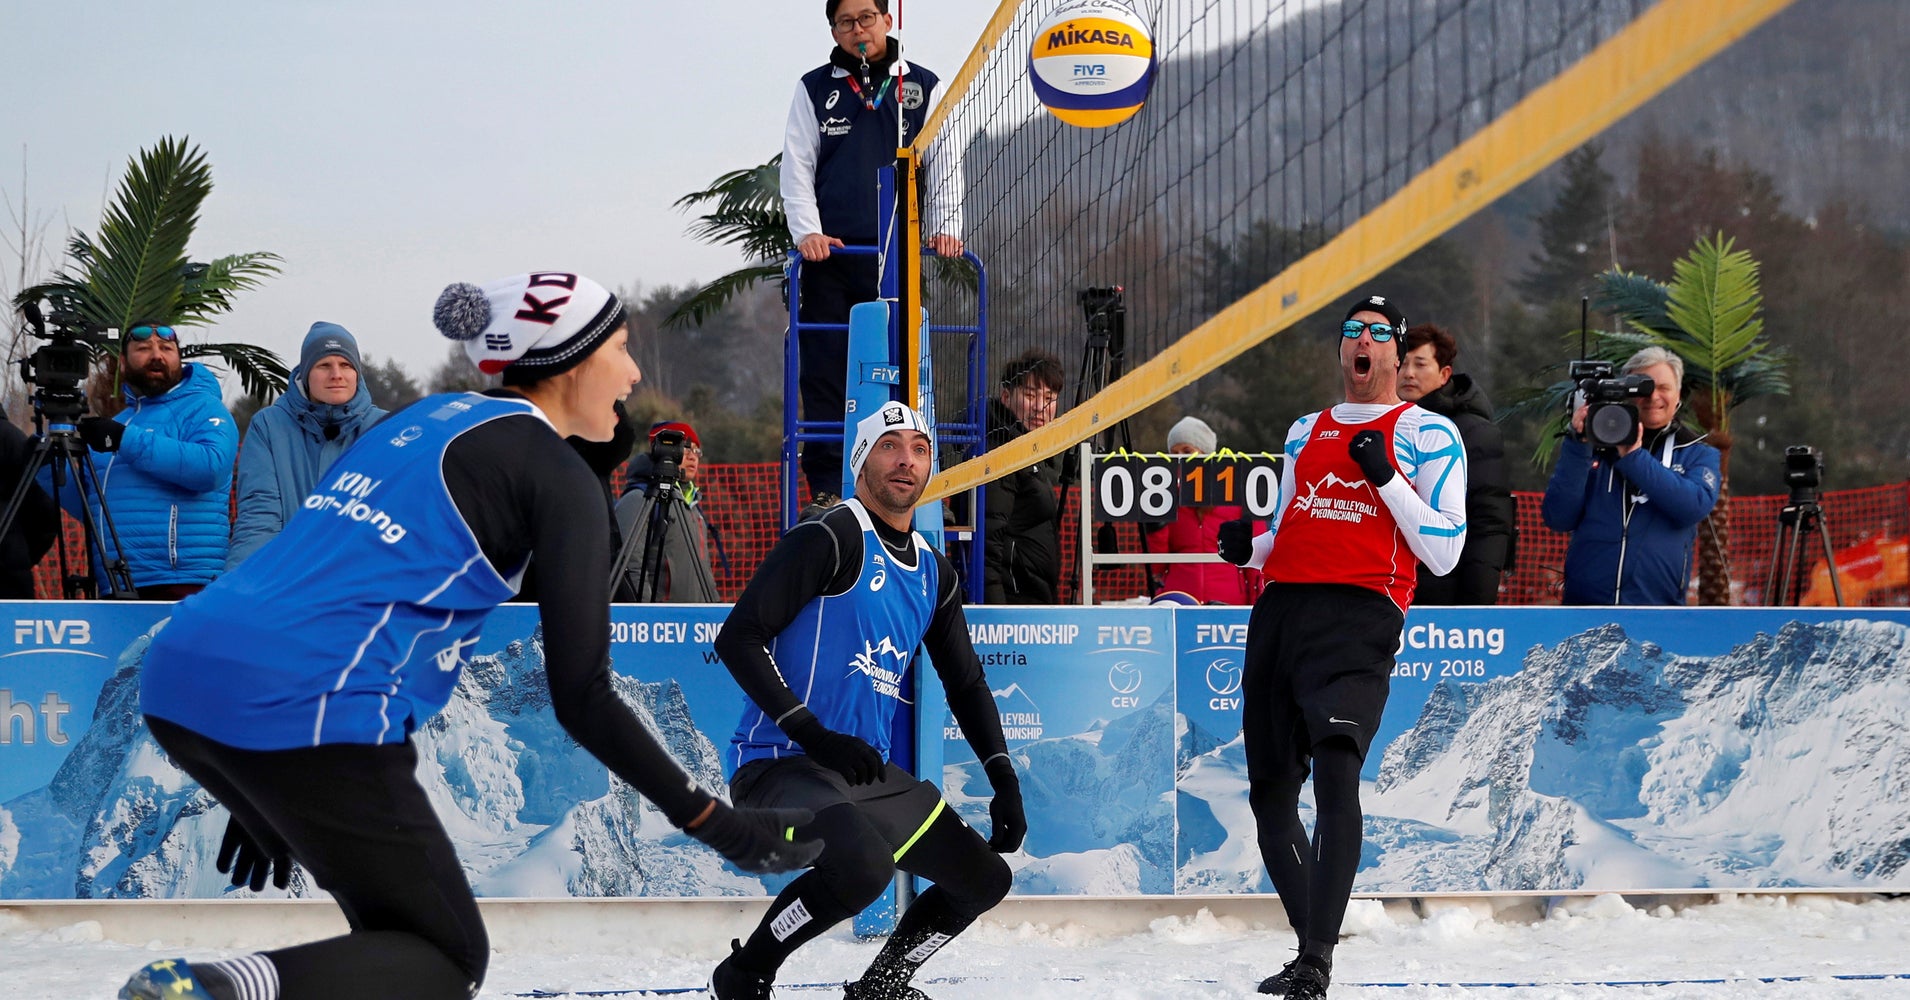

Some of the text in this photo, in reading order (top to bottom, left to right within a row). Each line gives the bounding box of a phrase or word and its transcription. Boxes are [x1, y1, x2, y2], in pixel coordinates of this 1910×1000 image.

[1047, 24, 1134, 50] MIKASA
[1073, 64, 1105, 76] FIVB
[871, 368, 899, 382] FIV
[1319, 430, 1340, 438] FIVB
[1100, 465, 1174, 517] 08
[1310, 508, 1362, 524] PYEONGCHANG
[1312, 497, 1378, 517] SNOW VOLLEYBALL
[15, 619, 92, 645] FIVB
[609, 622, 649, 643] 2018
[653, 622, 687, 643] CEV
[967, 624, 1079, 645] HAMPIONSHIP
[1097, 626, 1153, 645] FIVB
[1197, 624, 1249, 643] FIVB
[980, 651, 1027, 666] ustria
[1440, 660, 1485, 677] 2018
[1111, 697, 1139, 708] CEV
[1209, 698, 1241, 710] CEV
[1001, 713, 1043, 726] LEYBALL
[771, 902, 808, 938] BURTON
